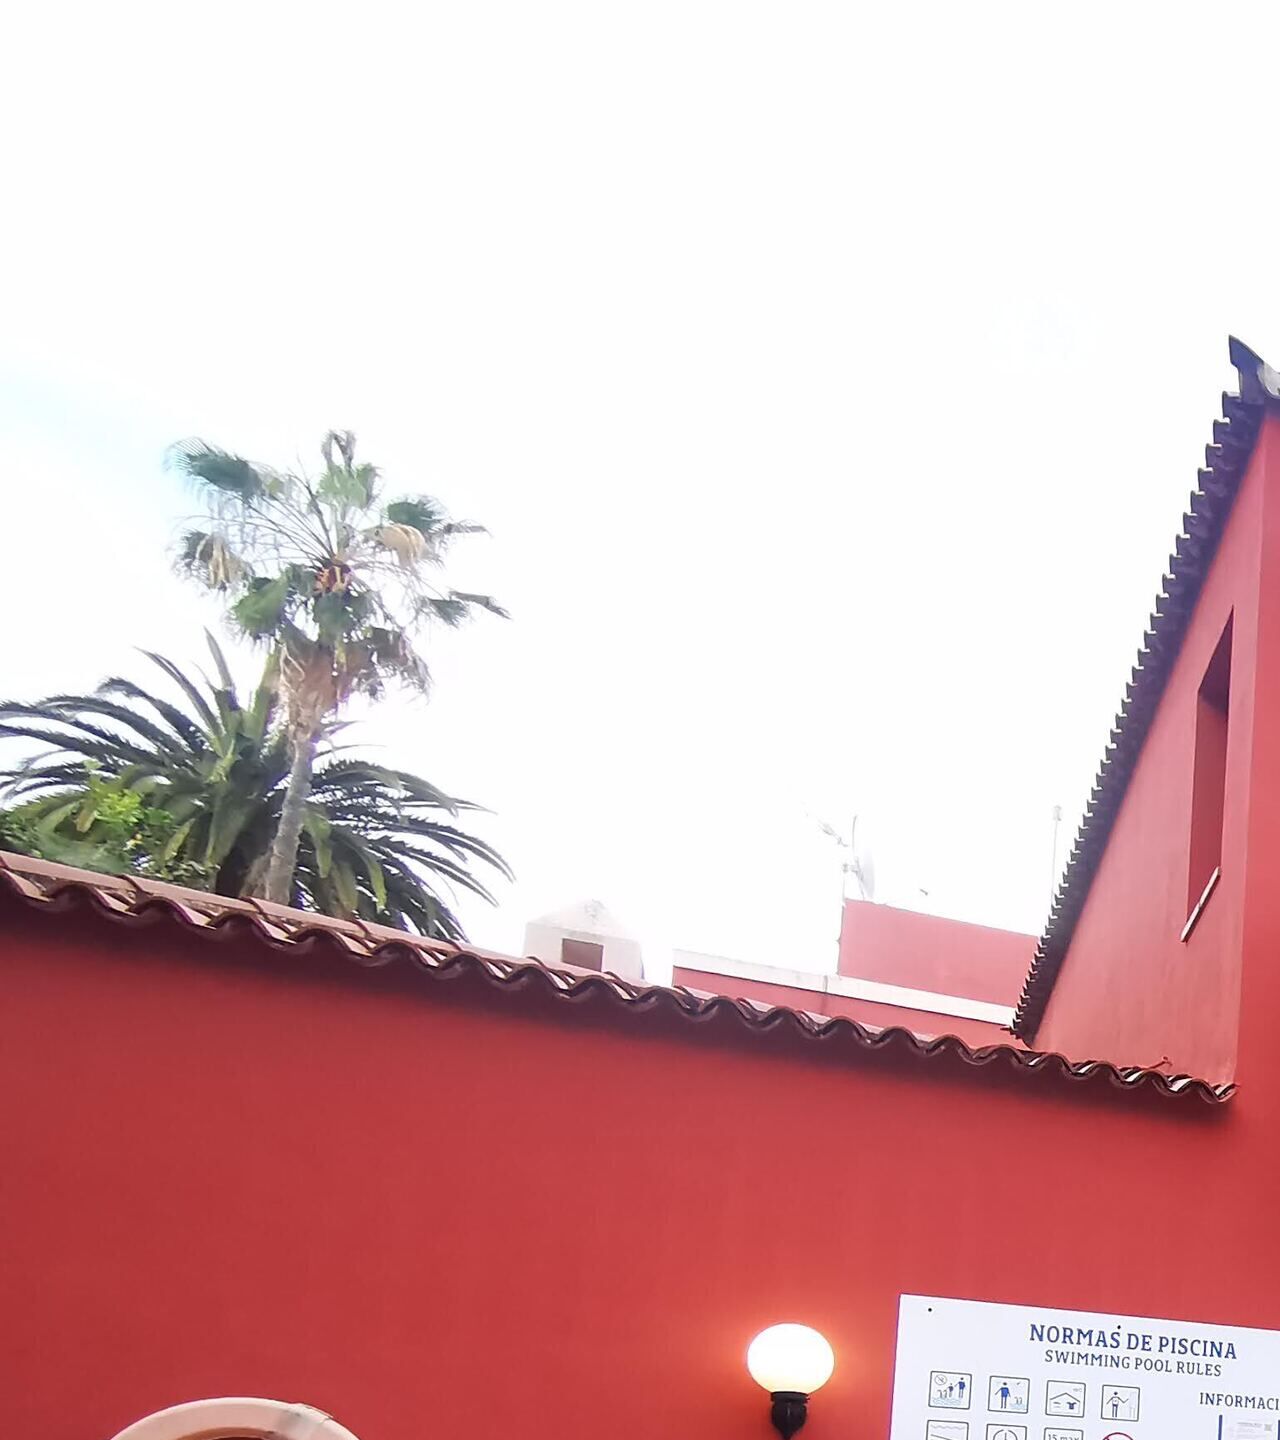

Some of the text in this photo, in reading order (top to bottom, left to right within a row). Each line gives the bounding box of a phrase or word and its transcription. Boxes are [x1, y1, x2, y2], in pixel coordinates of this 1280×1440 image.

[1029, 1324, 1238, 1360] NORMAS DE PISCINA
[1044, 1350, 1222, 1377] SWIMMING POOL RULES
